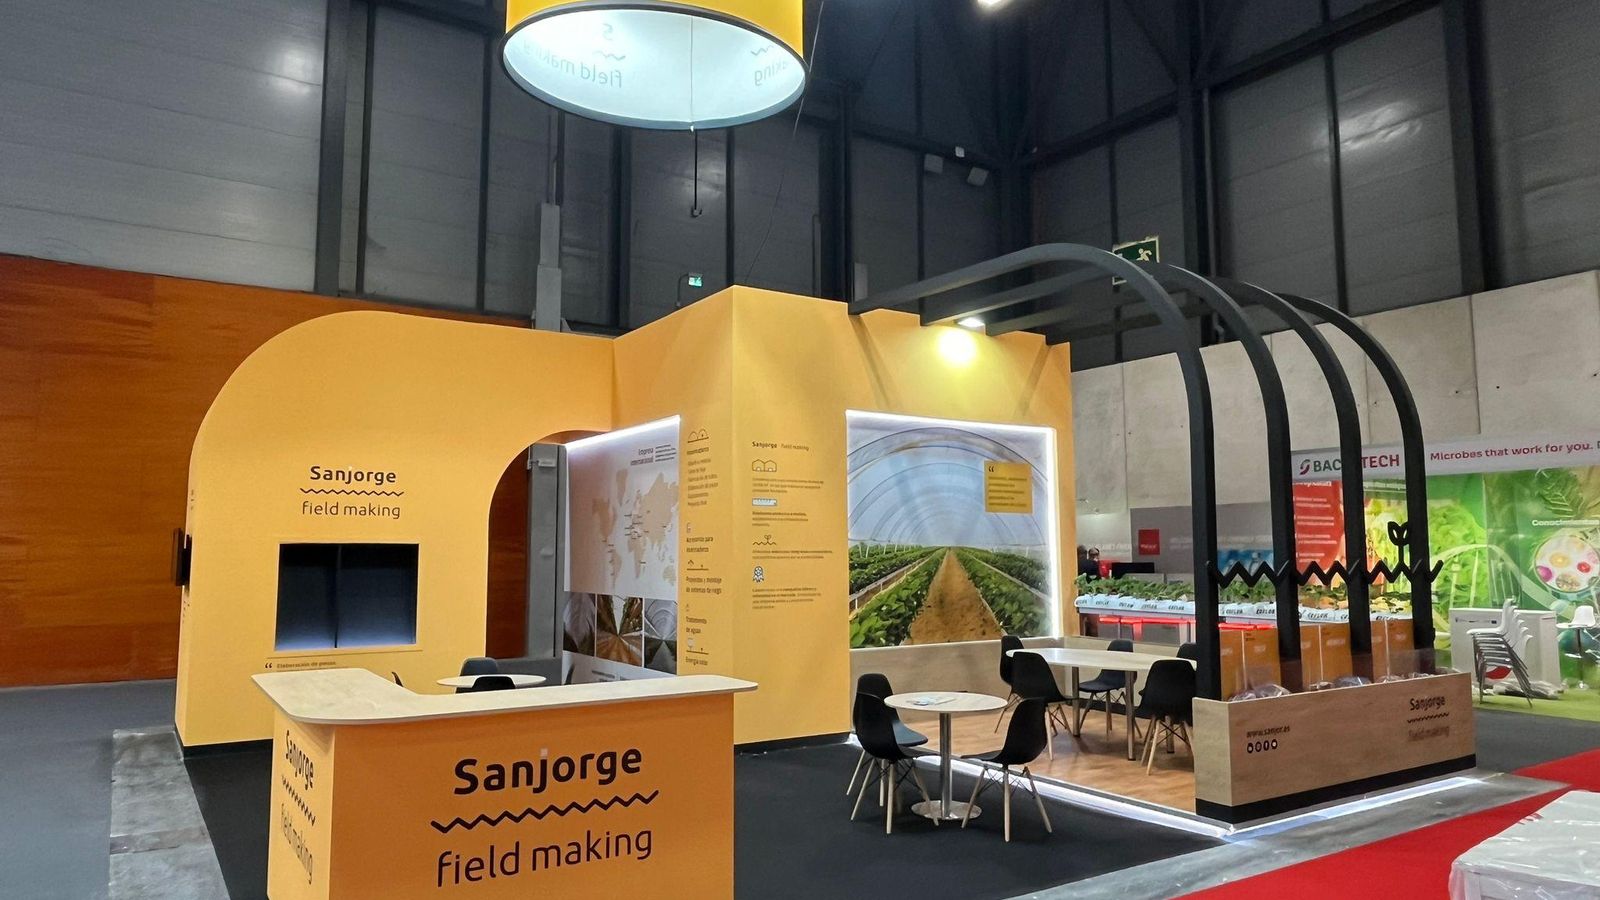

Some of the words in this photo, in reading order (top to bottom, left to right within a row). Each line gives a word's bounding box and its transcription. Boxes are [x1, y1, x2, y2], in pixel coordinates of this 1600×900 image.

[752, 441, 777, 449] Sanjorge
[1430, 451, 1483, 461] Microbes
[1485, 449, 1509, 457] that
[1512, 445, 1542, 454] work
[1545, 443, 1564, 453] for
[1566, 442, 1593, 453] you.
[310, 465, 397, 486] Sanjorge
[302, 500, 340, 516] field
[343, 502, 401, 520] making
[1410, 696, 1445, 711] Sanjorge
[285, 729, 314, 791] Sanjorge
[454, 747, 642, 795] Sanjorge
[437, 841, 520, 888] field
[531, 829, 652, 871] making
